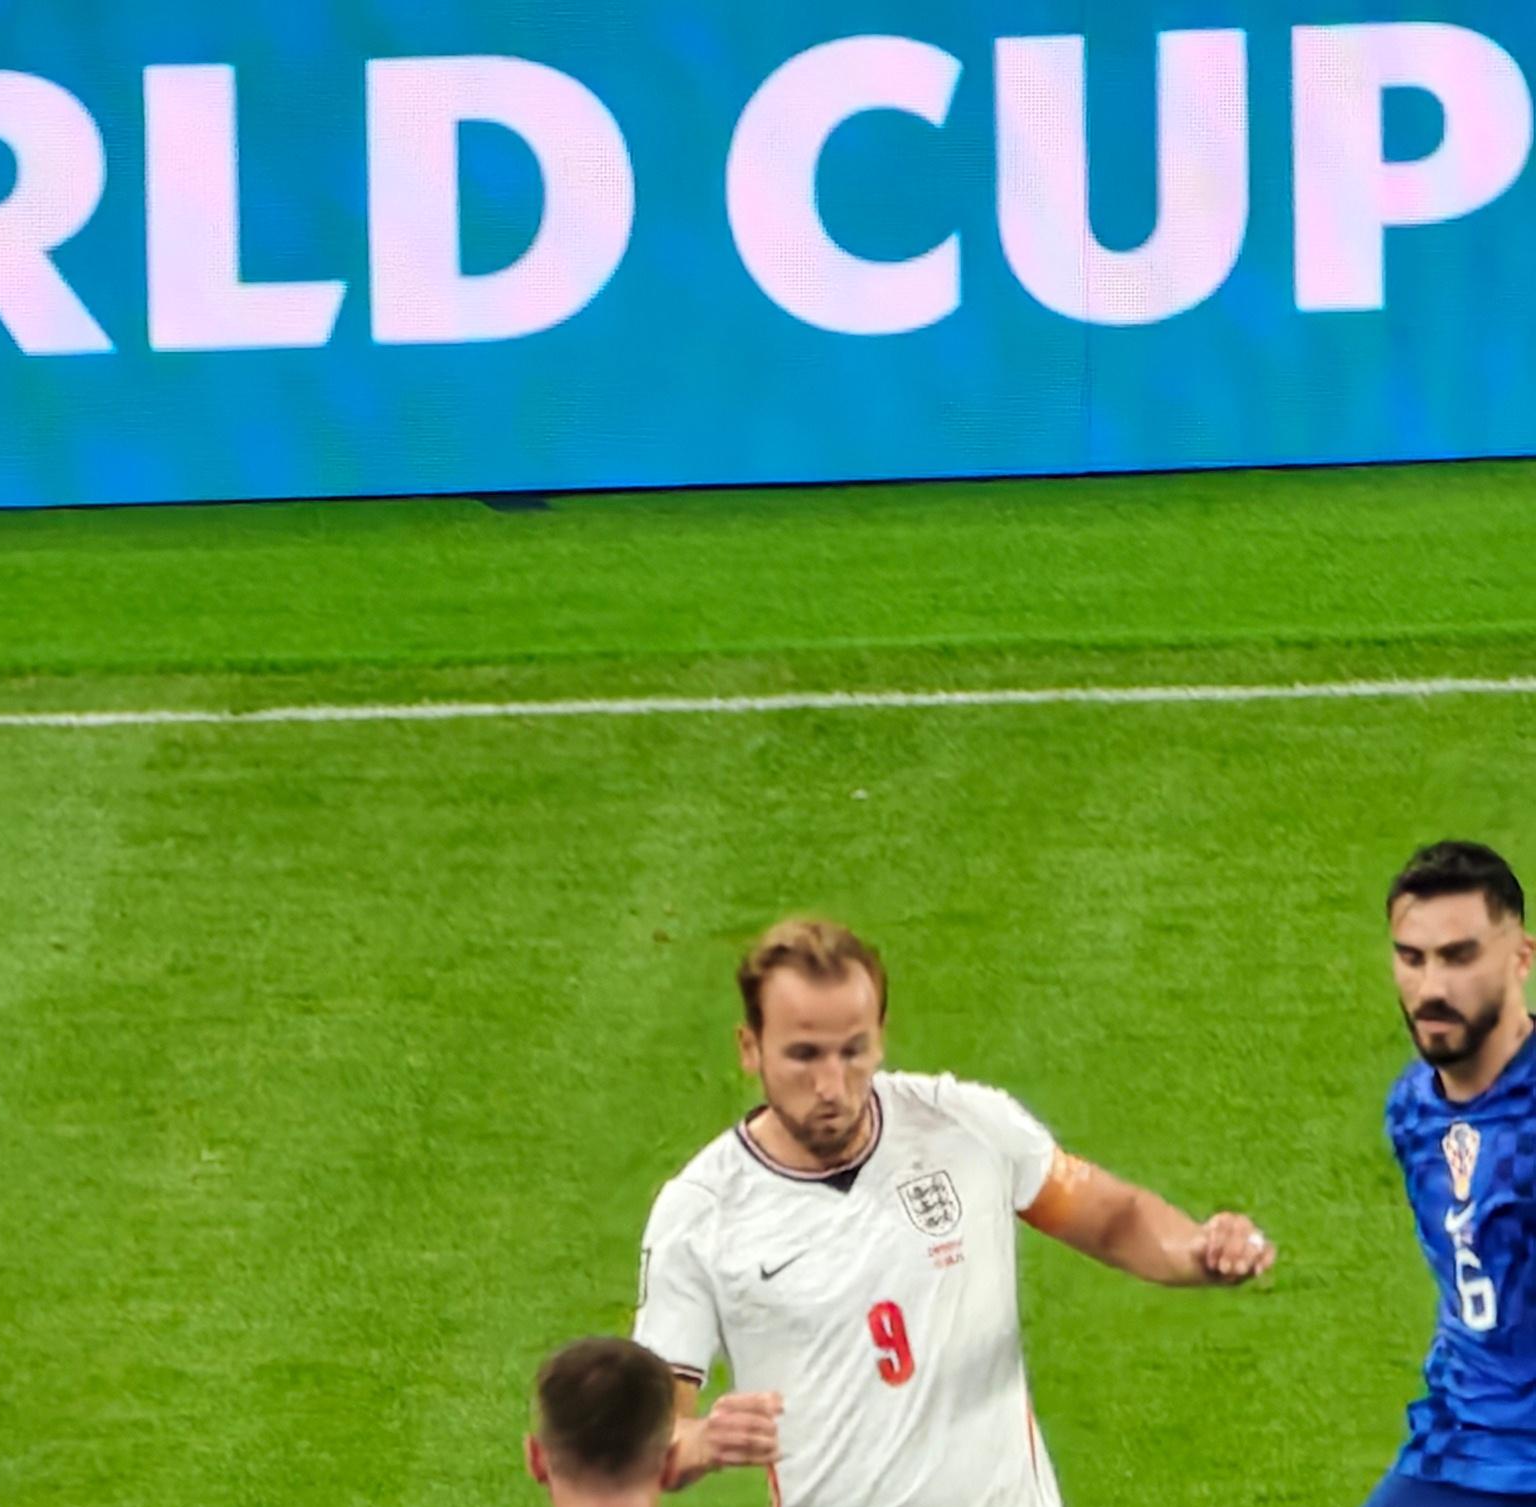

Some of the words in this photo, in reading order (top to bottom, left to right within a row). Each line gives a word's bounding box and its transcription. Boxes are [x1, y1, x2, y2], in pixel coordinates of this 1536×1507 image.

[727, 24, 1533, 333] CUP
[1454, 1248, 1497, 1332] 6
[867, 1299, 916, 1386] 9
